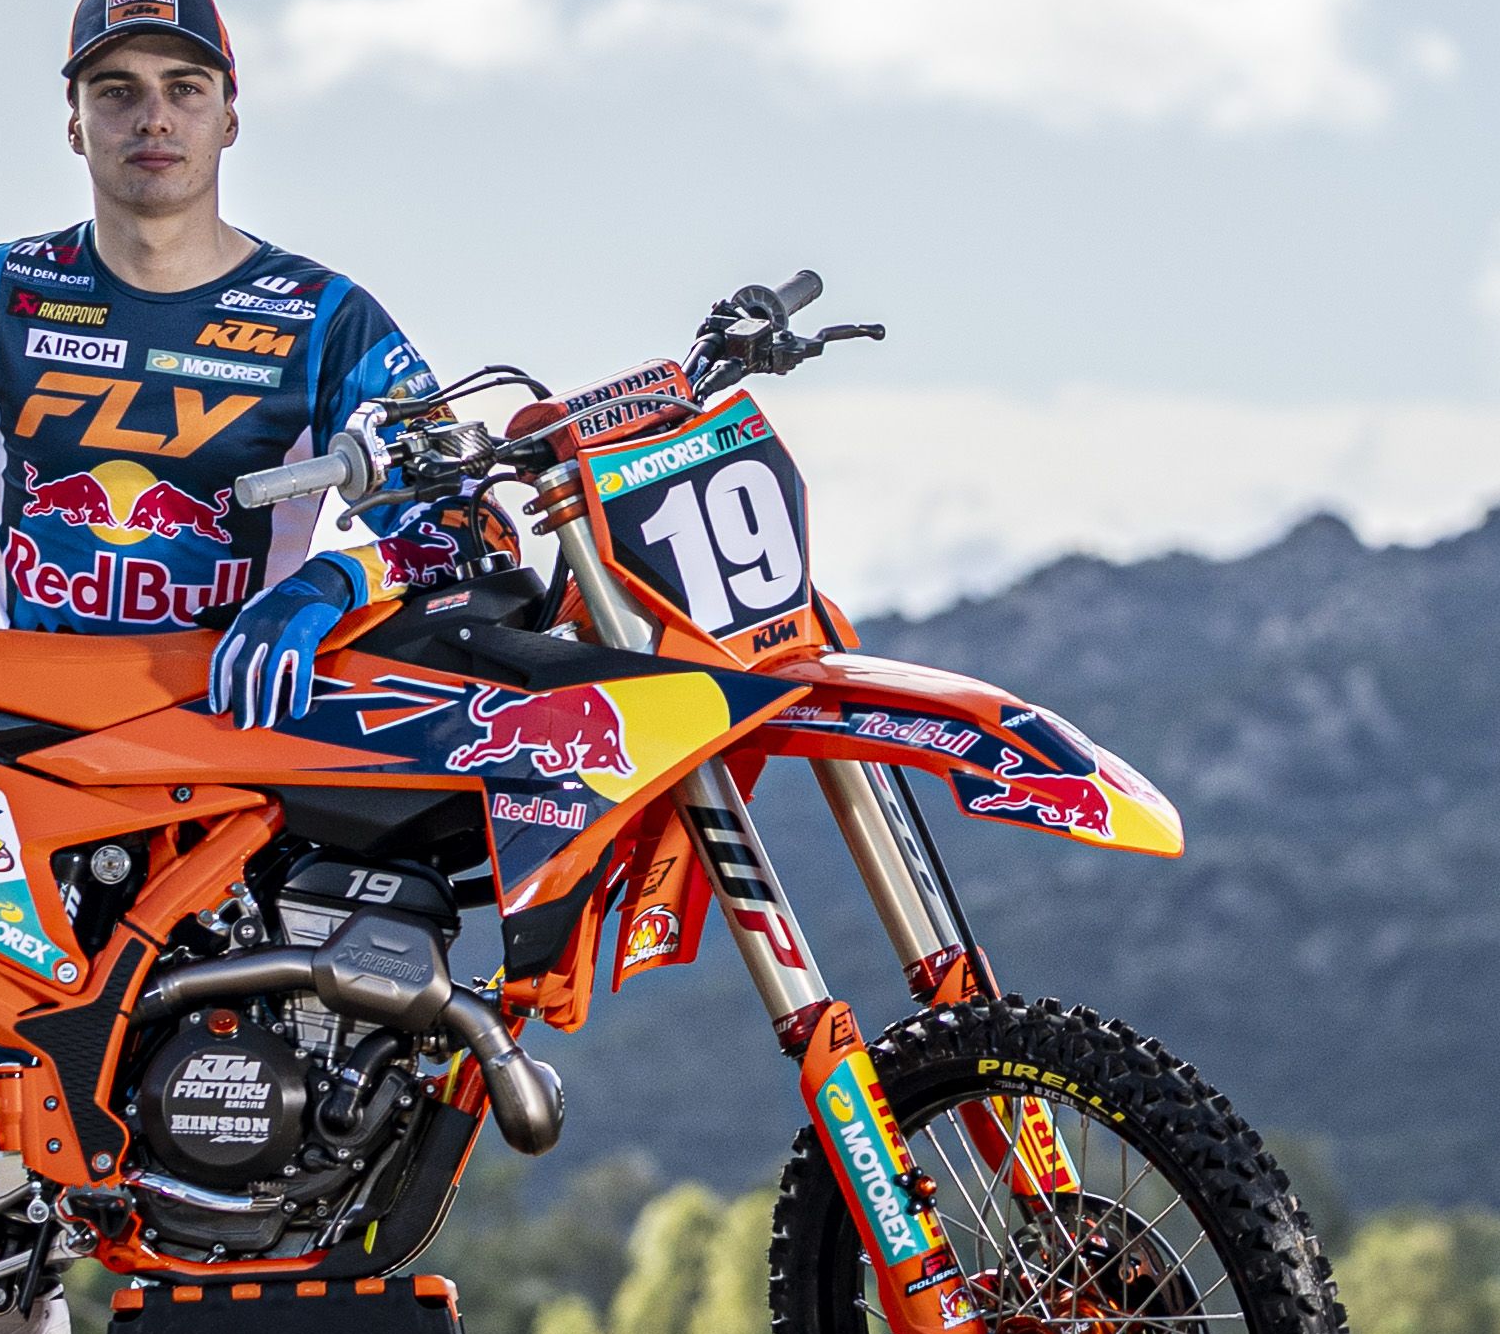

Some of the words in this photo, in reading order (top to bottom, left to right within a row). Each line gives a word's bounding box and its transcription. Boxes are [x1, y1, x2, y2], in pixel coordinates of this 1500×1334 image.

[6, 260, 30, 276] VAN
[33, 268, 57, 280] DEN
[60, 273, 91, 285] BOER
[38, 302, 108, 325] AKRAPOVIC
[33, 334, 121, 364] AIROH
[195, 319, 296, 357] KTM
[182, 357, 272, 384] MOTOREX
[566, 366, 675, 415] RENTHAL
[13, 371, 263, 459] FLY
[578, 383, 688, 440] RENTHAL
[620, 432, 717, 487] MOTOREX
[715, 414, 767, 451] MX2
[641, 460, 801, 641] 19
[4, 527, 116, 620] Red
[118, 556, 252, 628] Bull
[752, 619, 799, 655] KTM
[781, 705, 822, 717] IROH
[857, 712, 922, 741] Red
[916, 719, 981, 757] Bull
[492, 793, 538, 824] Red
[539, 797, 587, 830] Bull
[343, 869, 404, 905] 19
[359, 950, 429, 983] AKRAPOVIČ
[182, 1054, 261, 1082] KTM
[172, 1080, 271, 1100] FACTORY
[978, 1059, 1125, 1122] PIRELLI
[1034, 1086, 1078, 1108] EXCEL
[171, 1115, 270, 1132] HINSON
[840, 1121, 916, 1257] MOTOREX
